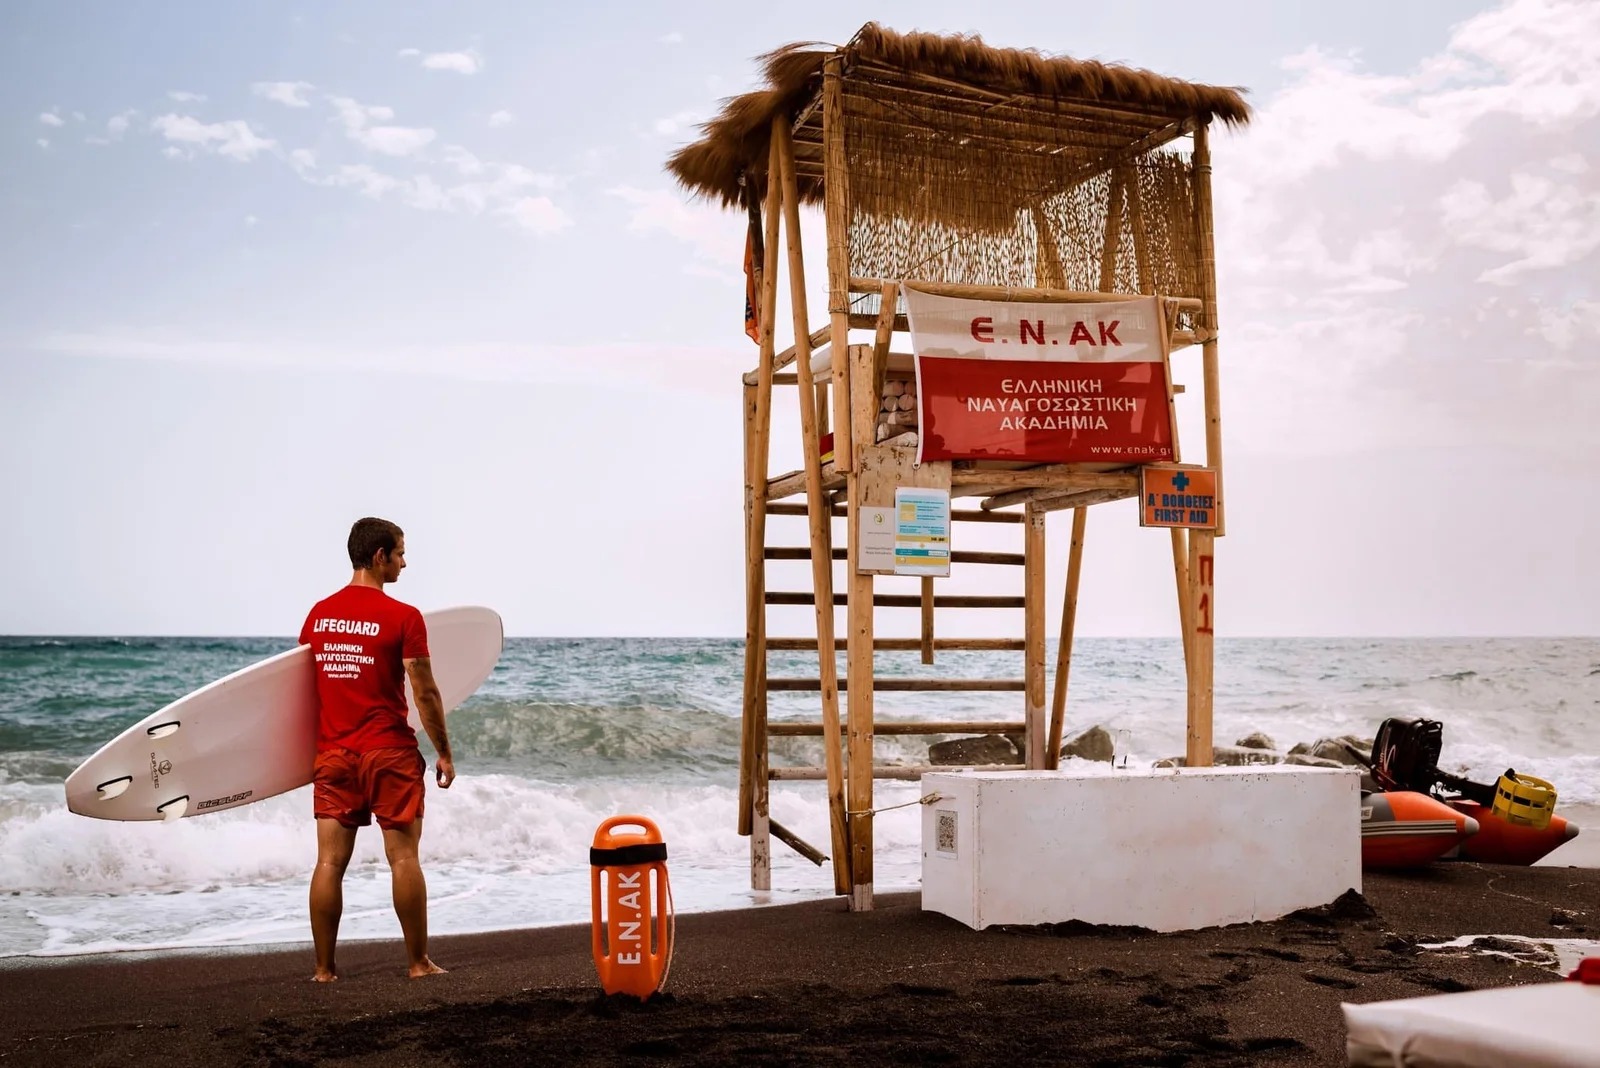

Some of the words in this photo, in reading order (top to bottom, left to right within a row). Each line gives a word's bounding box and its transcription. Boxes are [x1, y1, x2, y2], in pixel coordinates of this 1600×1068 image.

[1001, 378, 1102, 394] ΕΛΛΗΝΙΚΗ
[967, 397, 1137, 413] ΝΑΥΑΓΟΣΩΣΤΙΚΗ
[999, 415, 1109, 431] ΑΚΑΔΗΜΙΑ
[1154, 508, 1184, 522] FIRST
[1189, 510, 1208, 523] AID
[313, 618, 380, 637] LIFEGUARD
